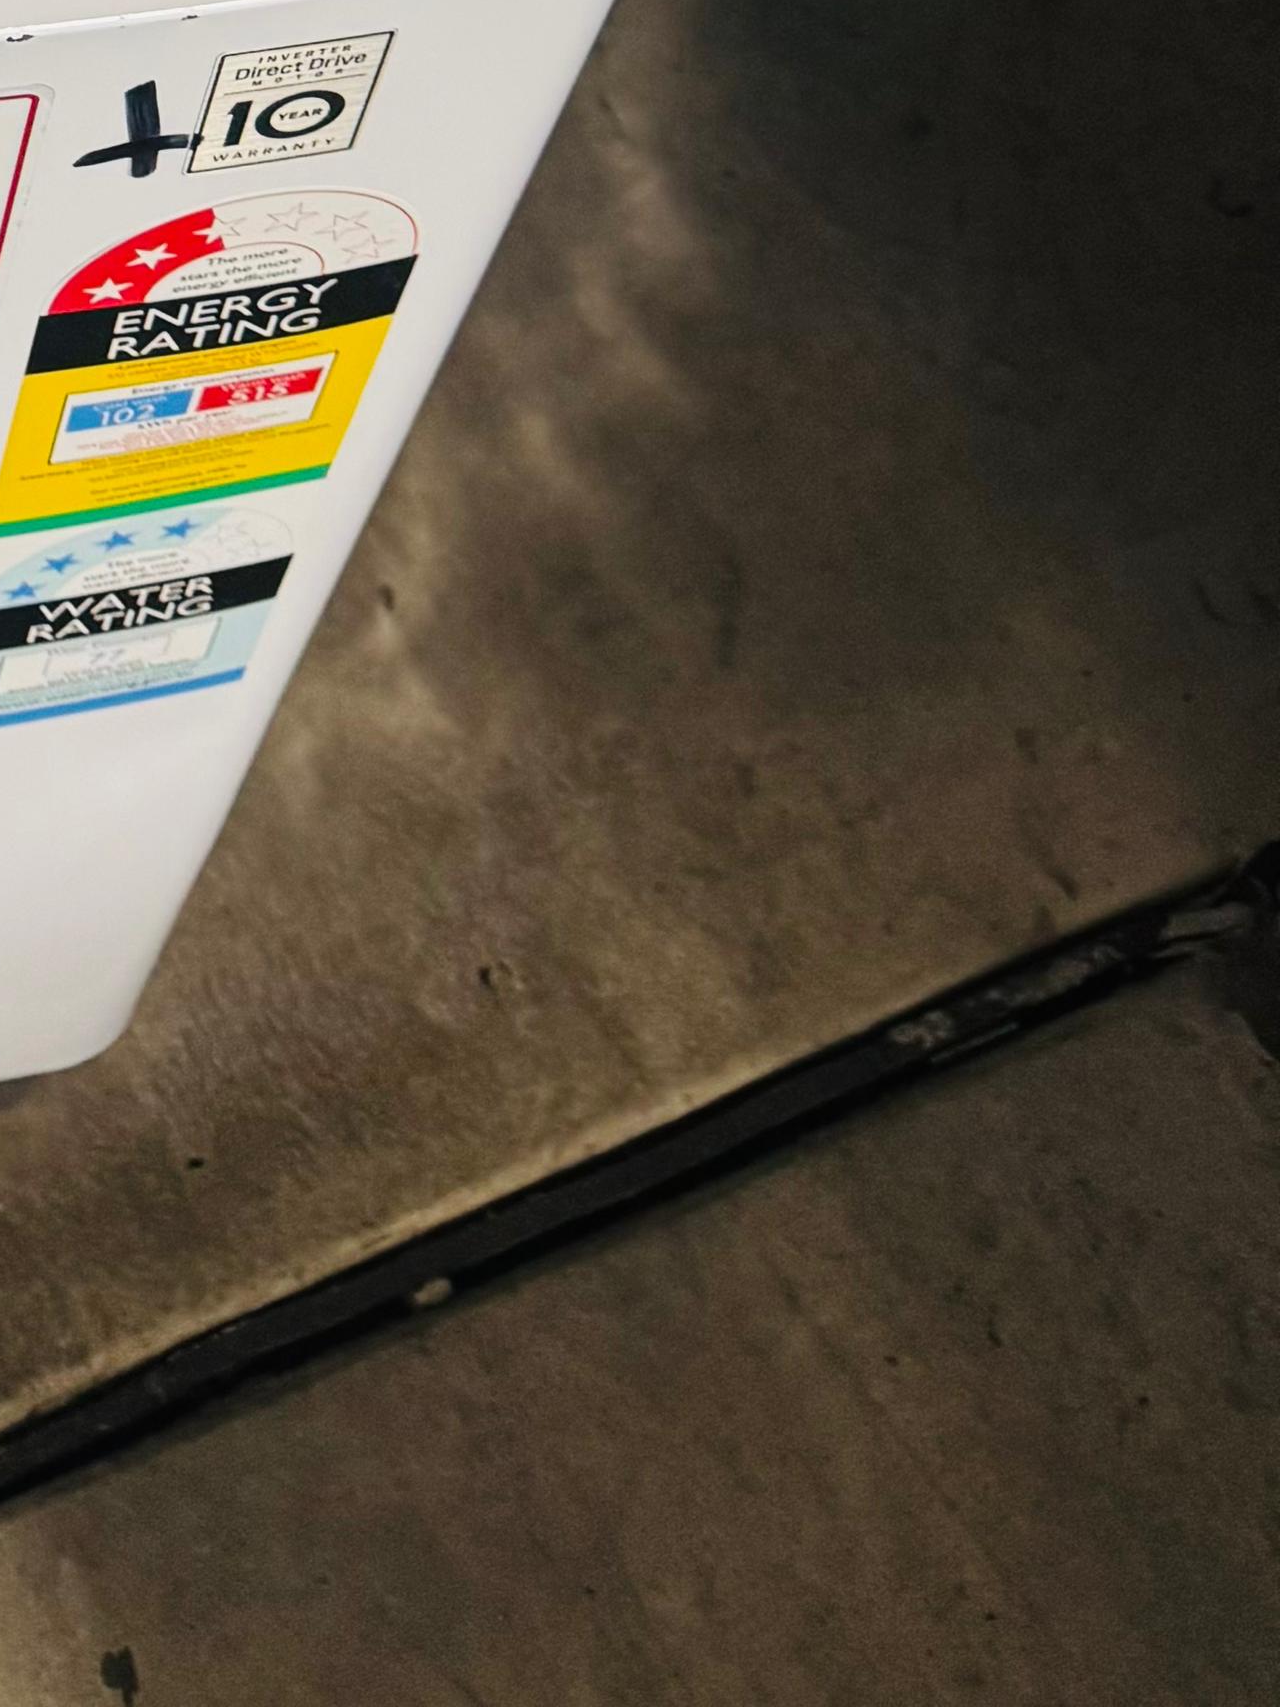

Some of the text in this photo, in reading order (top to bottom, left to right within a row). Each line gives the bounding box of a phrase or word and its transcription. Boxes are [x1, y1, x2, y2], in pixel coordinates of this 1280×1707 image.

[235, 53, 367, 81] Direct Drive
[258, 44, 353, 64] INVERTER
[252, 68, 344, 87] MOTOR
[223, 89, 346, 147] 10
[278, 107, 324, 121] YEAR
[212, 137, 336, 163] WARRANTY
[113, 278, 338, 335] ENERGY
[107, 307, 323, 360] RATING
[40, 576, 213, 622] WATER
[26, 595, 213, 643] RATING
